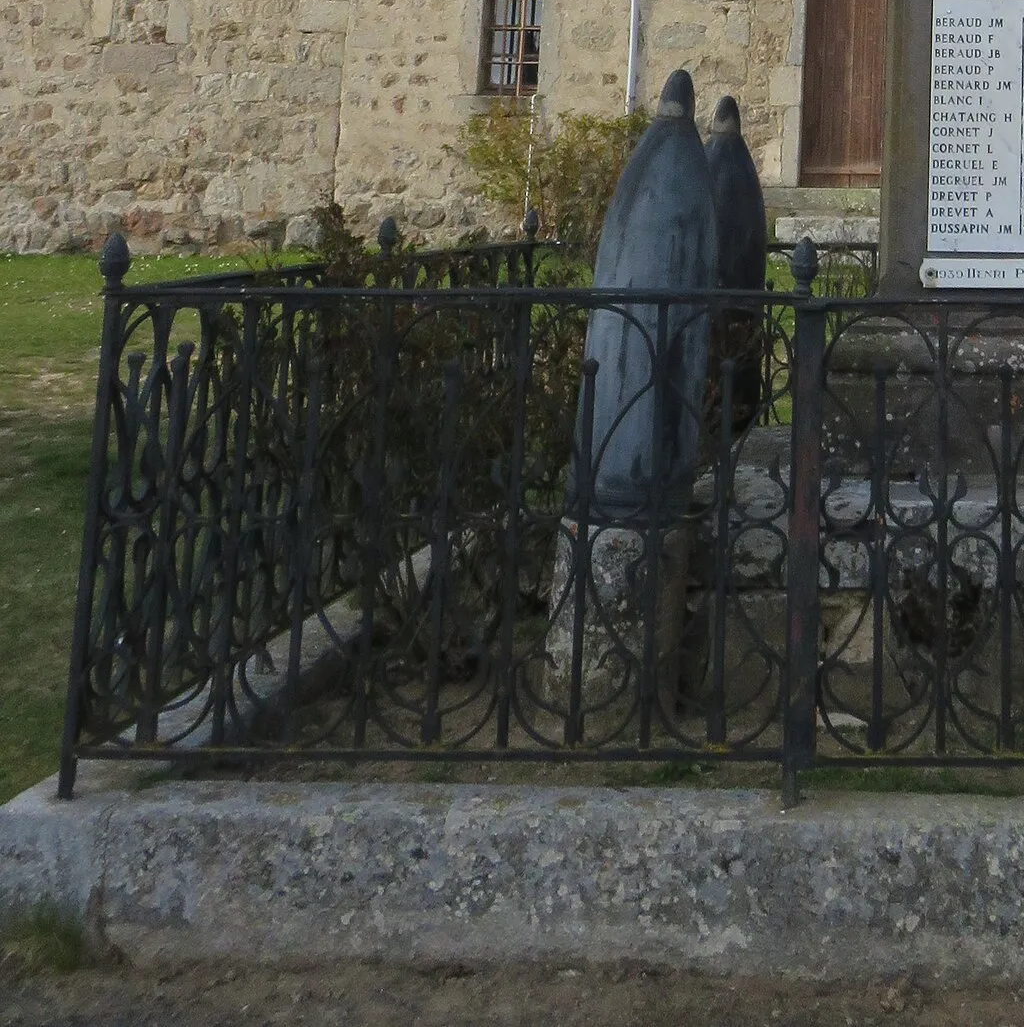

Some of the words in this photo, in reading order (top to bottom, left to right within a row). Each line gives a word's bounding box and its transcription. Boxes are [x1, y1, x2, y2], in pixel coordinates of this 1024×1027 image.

[935, 18, 982, 27] BERAUD
[989, 19, 1003, 27] JM
[935, 34, 982, 43] BERAUD
[989, 35, 994, 43] F
[935, 49, 981, 58] BERAUD
[988, 50, 1000, 58] JB
[934, 65, 981, 75] BERAUD
[988, 66, 994, 75] P
[934, 81, 989, 90] BERNARD
[996, 81, 1011, 90] JM
[934, 96, 973, 105] BLANC
[933, 112, 996, 122] CHATAING
[1005, 113, 1012, 122] H
[933, 128, 980, 137] CORNET
[988, 128, 993, 137] J
[932, 144, 979, 154] CORNET
[988, 144, 993, 153] L
[933, 160, 984, 170] DEGRUEL
[993, 161, 997, 170] E
[932, 176, 984, 185] DEGRUEL
[993, 177, 1007, 186] JM
[932, 192, 978, 200] DREVET
[986, 192, 992, 201] P
[932, 208, 977, 217] DREVET
[986, 208, 993, 217] A
[931, 224, 989, 234] DUSSAPIN
[997, 225, 1012, 234] JM
